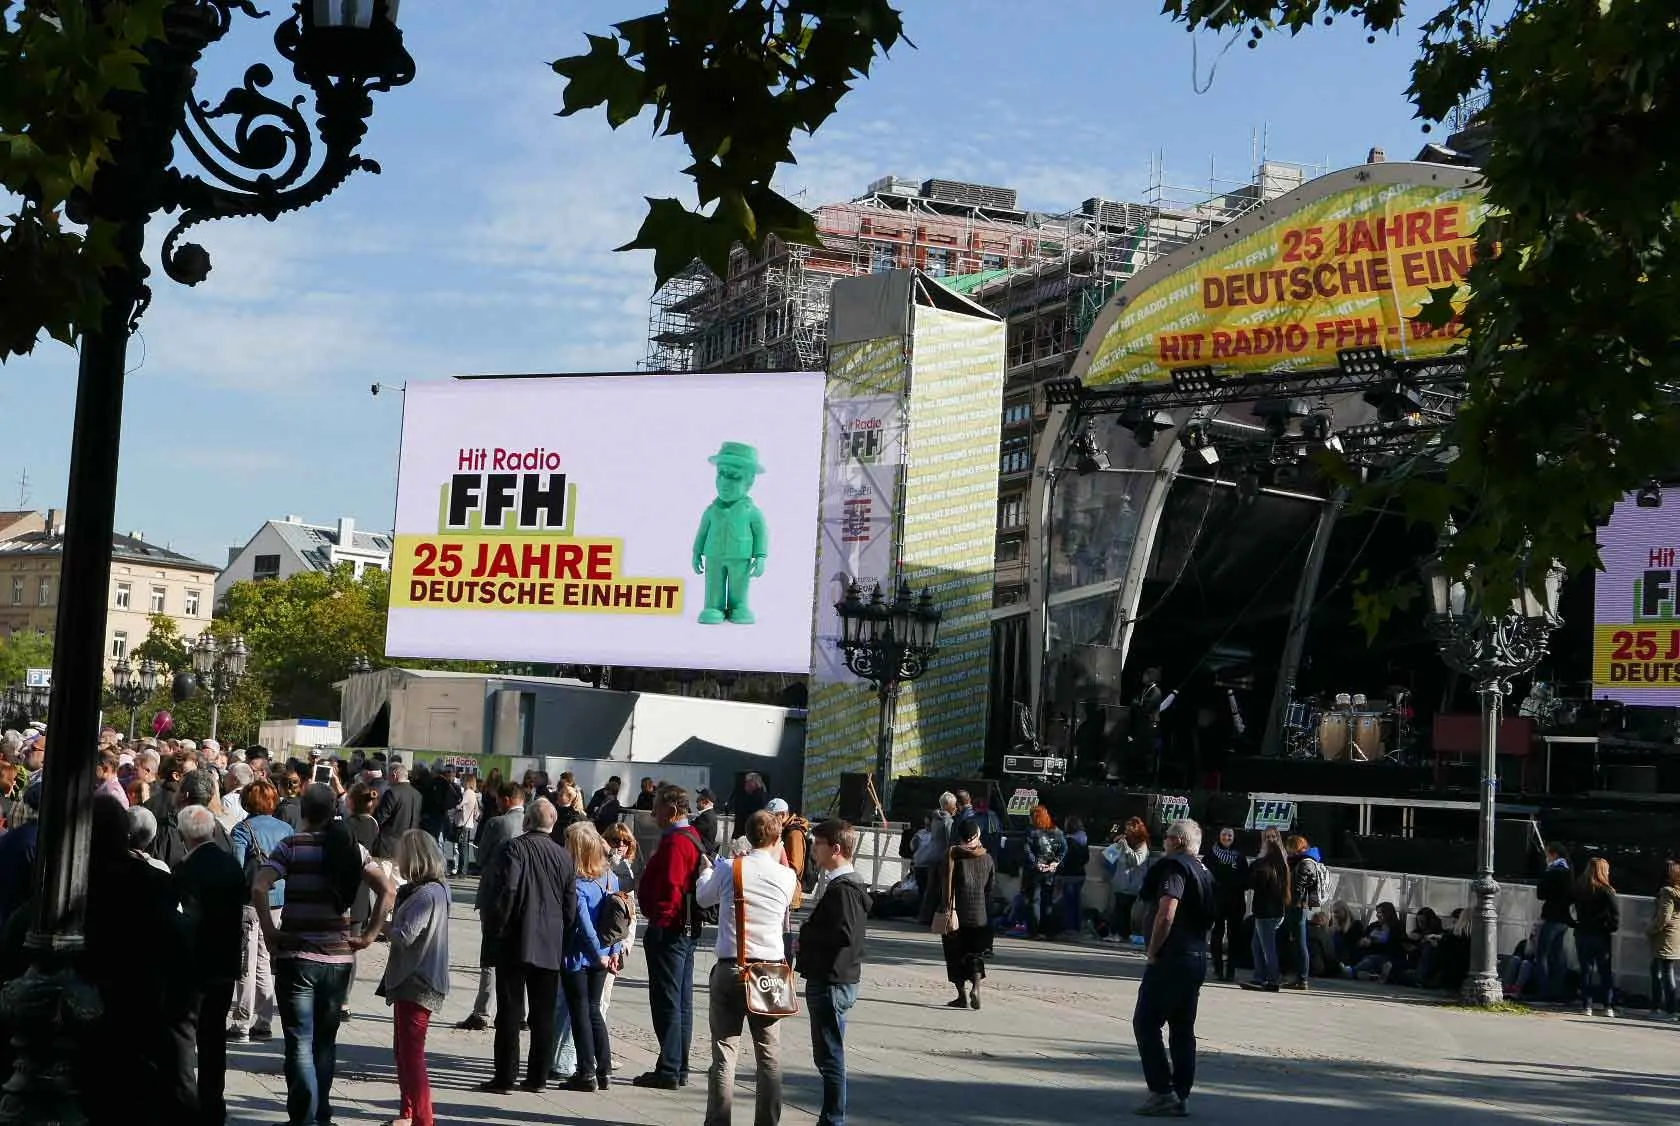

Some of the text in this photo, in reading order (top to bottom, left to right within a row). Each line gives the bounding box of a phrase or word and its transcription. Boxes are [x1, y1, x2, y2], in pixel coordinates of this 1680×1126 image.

[1282, 226, 1324, 263] 25
[1335, 206, 1459, 257] JAHRE
[1203, 257, 1393, 309] DEUTSCHE
[1137, 296, 1168, 321] RADIO
[1160, 333, 1204, 362] HIT
[1212, 323, 1309, 358] RADIO
[1316, 317, 1378, 349] FFH
[855, 416, 882, 429] Radio
[458, 447, 561, 471] Hit Radio
[447, 473, 567, 528] FFH
[412, 542, 613, 580] 25 JAHRE
[1649, 548, 1675, 568] Hit
[409, 580, 679, 610] DEUTSCHE EINHEIT
[1611, 630, 1657, 660] 25
[1255, 802, 1291, 820] FFH
